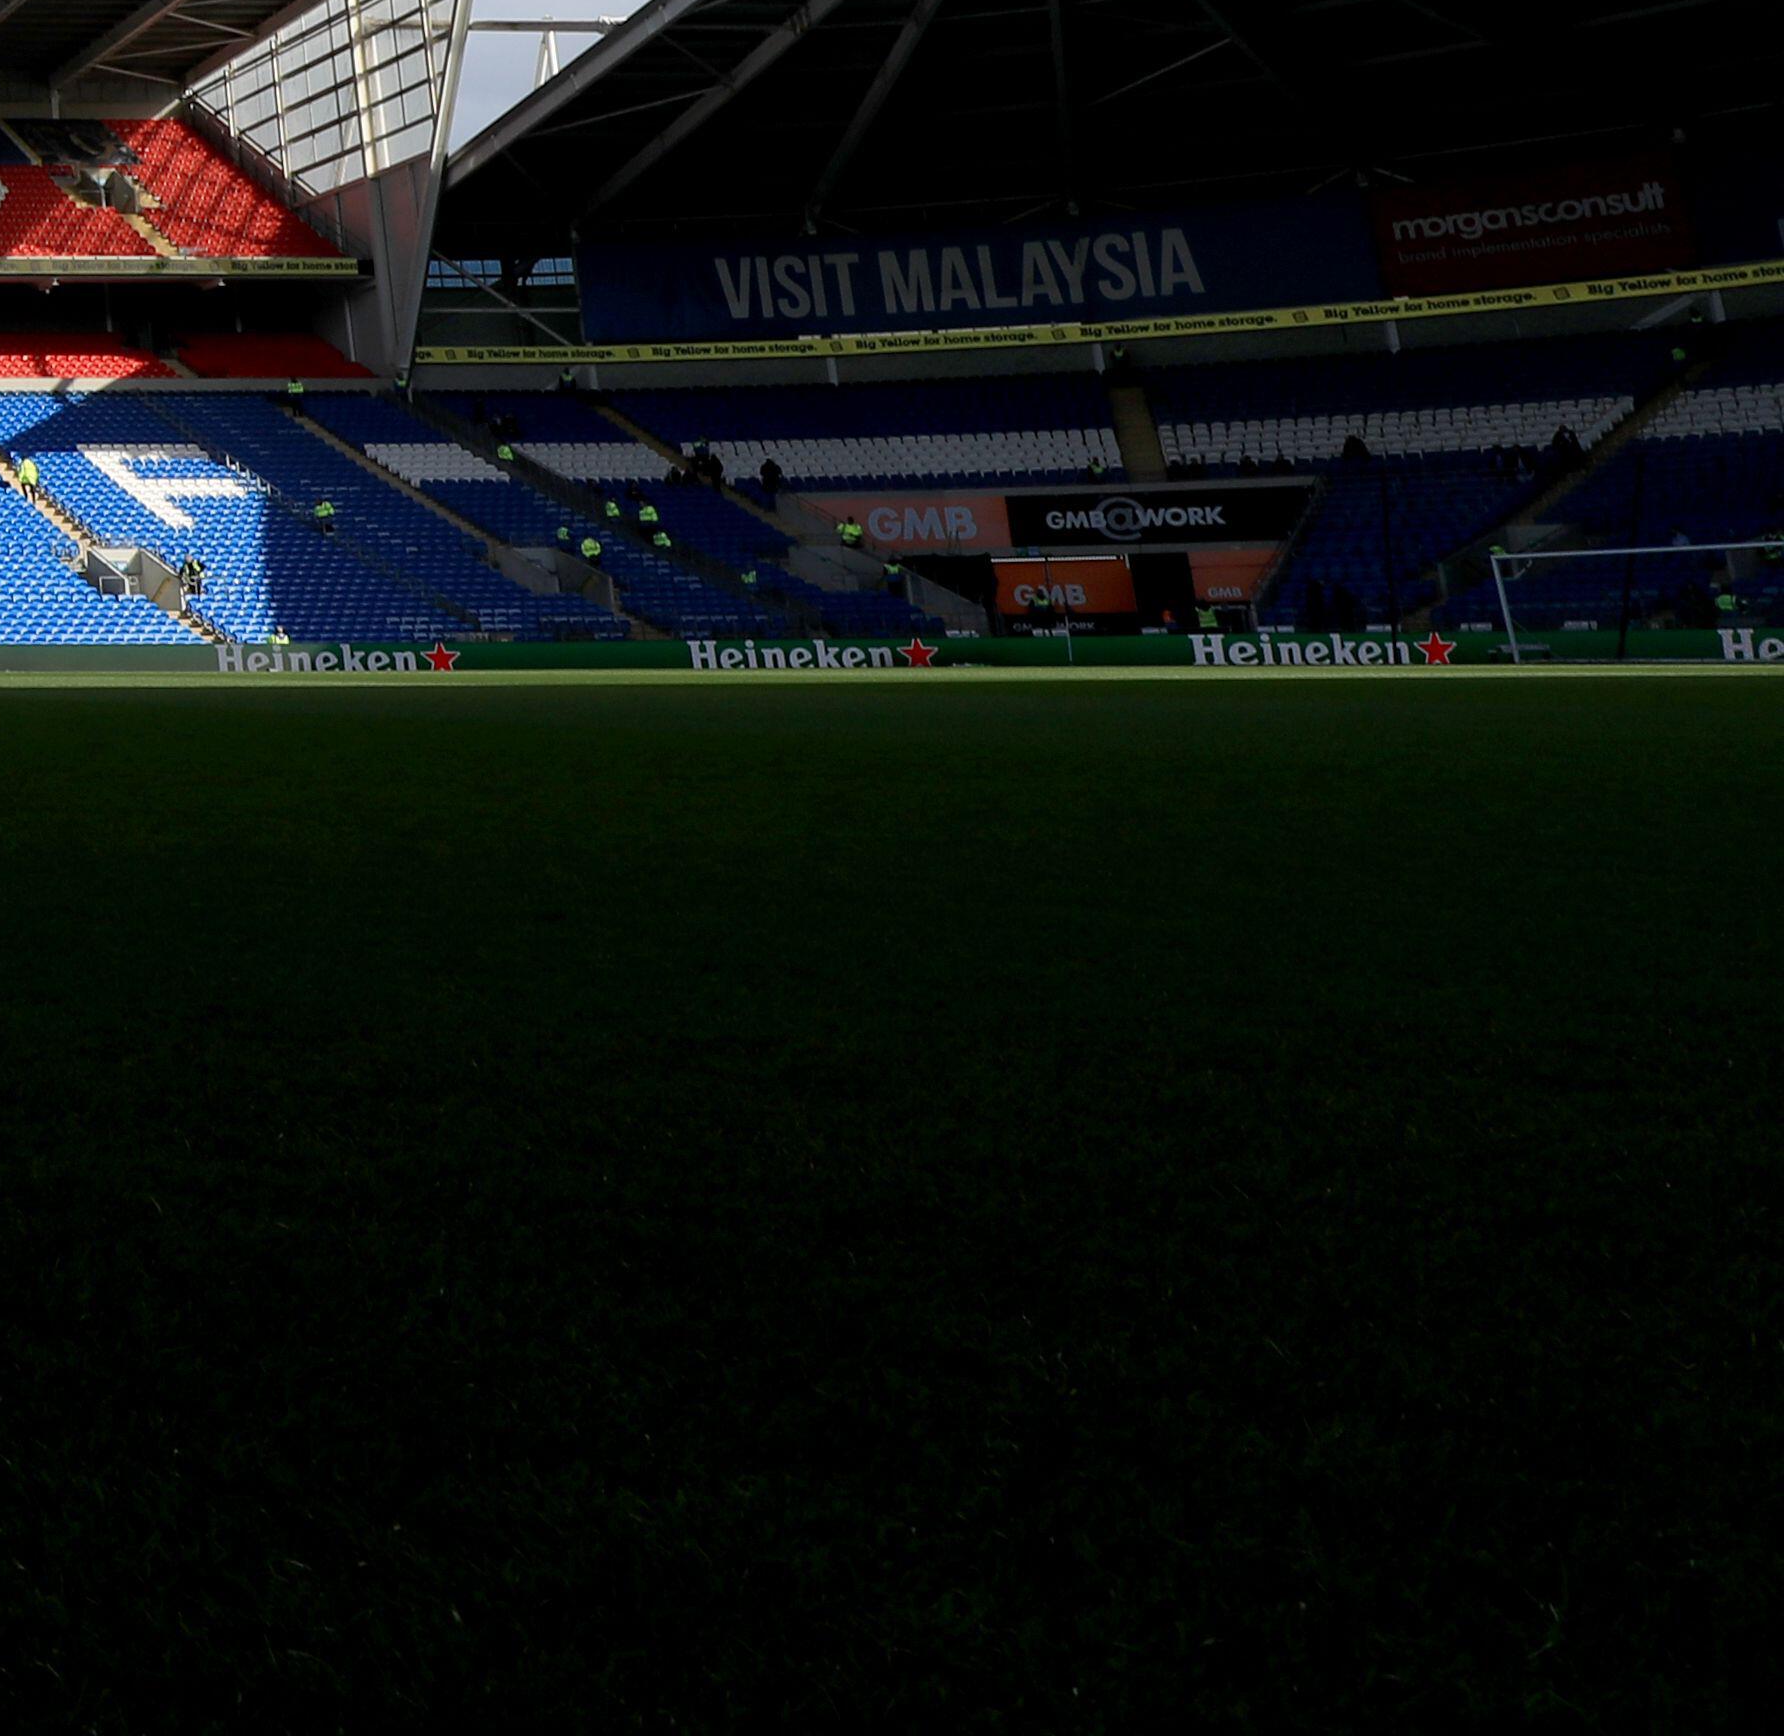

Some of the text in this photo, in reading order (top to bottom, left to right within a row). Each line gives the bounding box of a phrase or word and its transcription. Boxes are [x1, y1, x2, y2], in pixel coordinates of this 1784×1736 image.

[1392, 180, 1665, 240] morgansconsult
[714, 227, 1207, 319] VISIT MALAYSIA
[1588, 270, 1748, 296] Big Yellow for home
[1324, 308, 1348, 319] Big
[1352, 304, 1399, 316] Yellow
[1404, 302, 1422, 312] for
[1427, 299, 1470, 310] home
[856, 339, 875, 349] Big
[881, 338, 920, 347] Yellow
[924, 336, 940, 345] for
[944, 334, 980, 344] home
[1080, 327, 1102, 337] Big
[1106, 324, 1149, 334] Yellow
[1154, 322, 1170, 332] for
[1175, 320, 1214, 330] home
[652, 347, 670, 357] Big
[674, 346, 710, 355] Yellow
[714, 345, 729, 354] for
[732, 344, 766, 354] home
[868, 505, 977, 541] GMB
[1045, 497, 1227, 541] GMB@WORK
[1208, 586, 1243, 598] GMB
[214, 644, 417, 671] Heineken
[687, 638, 893, 668] Heineken
[1188, 632, 1410, 665] Heineken
